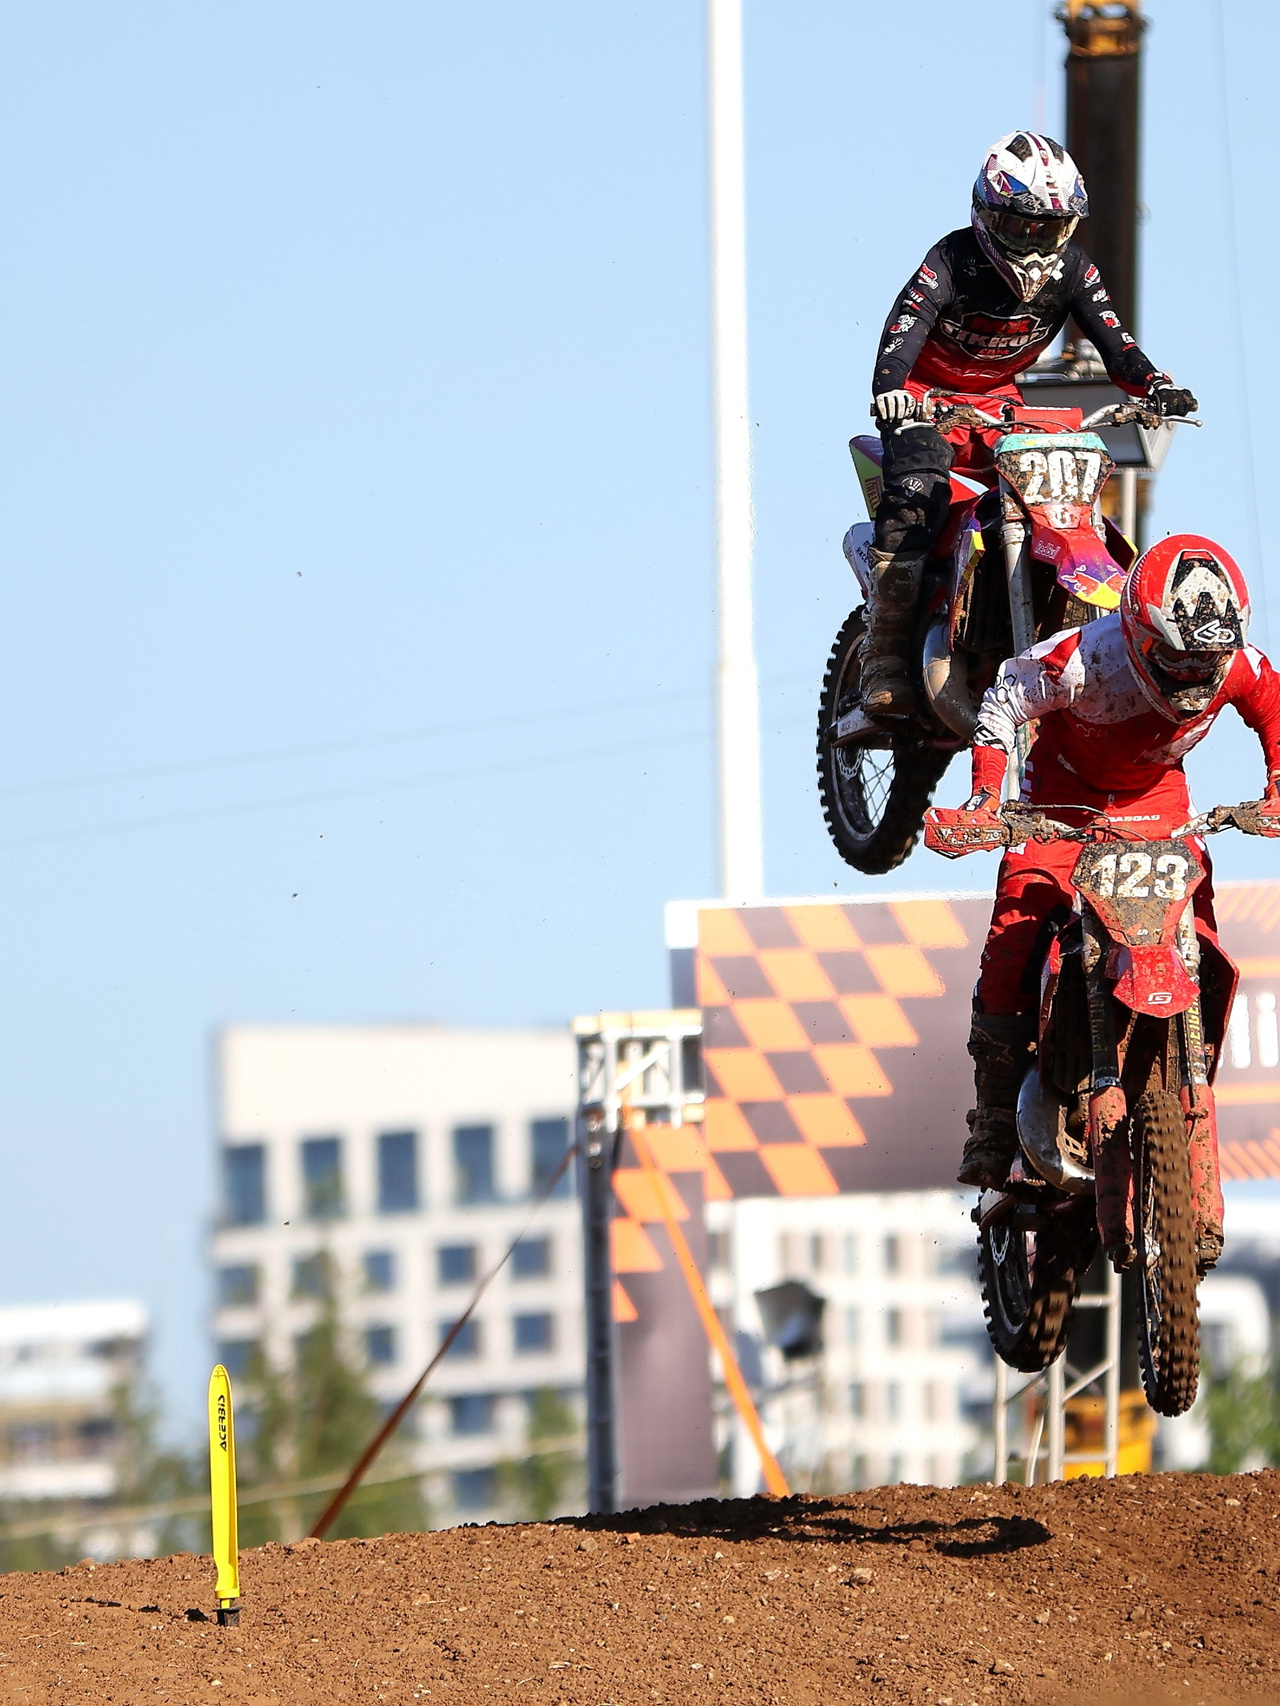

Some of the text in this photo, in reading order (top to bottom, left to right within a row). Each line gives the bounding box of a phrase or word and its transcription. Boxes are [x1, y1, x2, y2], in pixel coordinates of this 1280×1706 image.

[1019, 450, 1101, 504] 207
[1090, 852, 1189, 901] 123
[217, 1394, 228, 1452] ACERBIS
